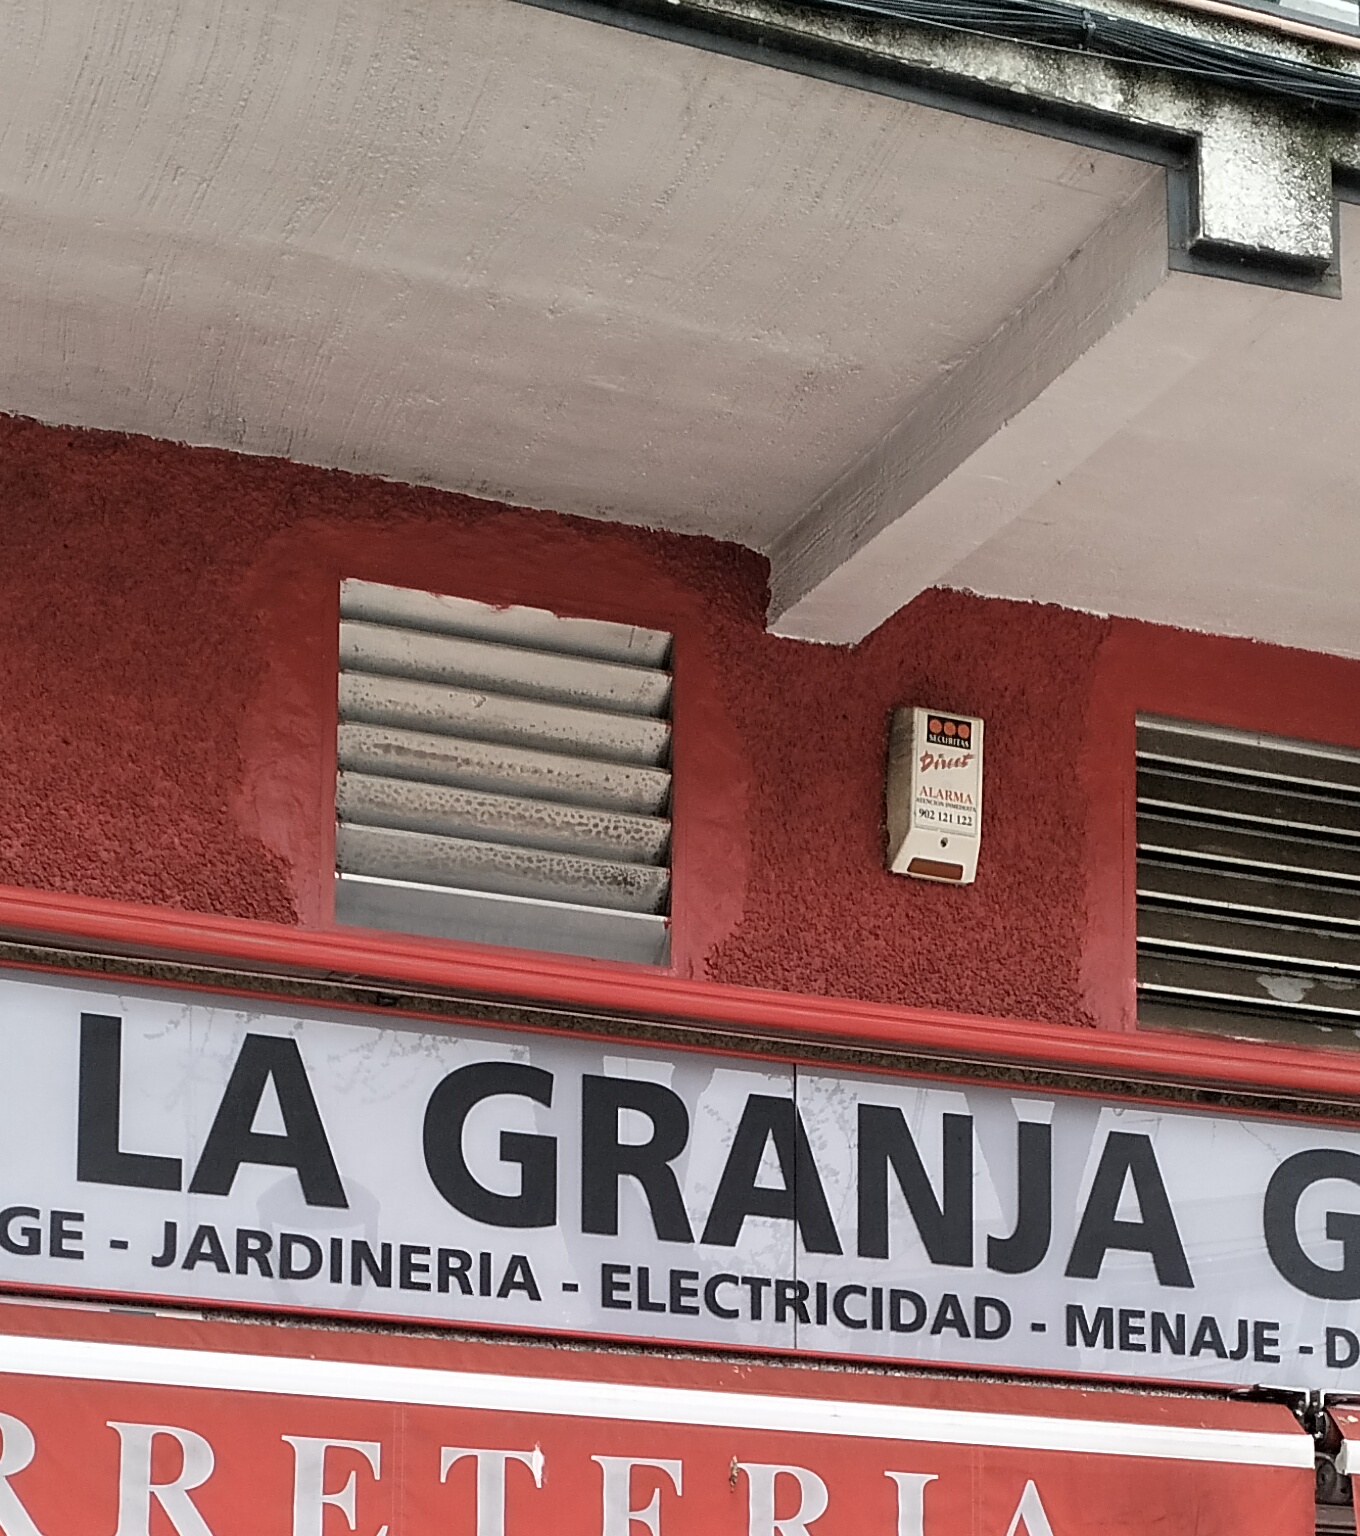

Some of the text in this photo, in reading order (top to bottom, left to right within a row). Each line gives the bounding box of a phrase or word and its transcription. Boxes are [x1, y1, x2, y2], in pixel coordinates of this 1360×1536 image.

[928, 734, 969, 747] SECURITAS
[919, 786, 973, 805] ALARMA
[919, 808, 973, 827] 902 121 122
[77, 1013, 349, 1209] LA
[422, 1061, 1194, 1290] GRANJA
[152, 1220, 542, 1303] JARDINERIA
[601, 1265, 1012, 1340] ELECTRICIDAD
[1066, 1303, 1280, 1365] MENAJE
